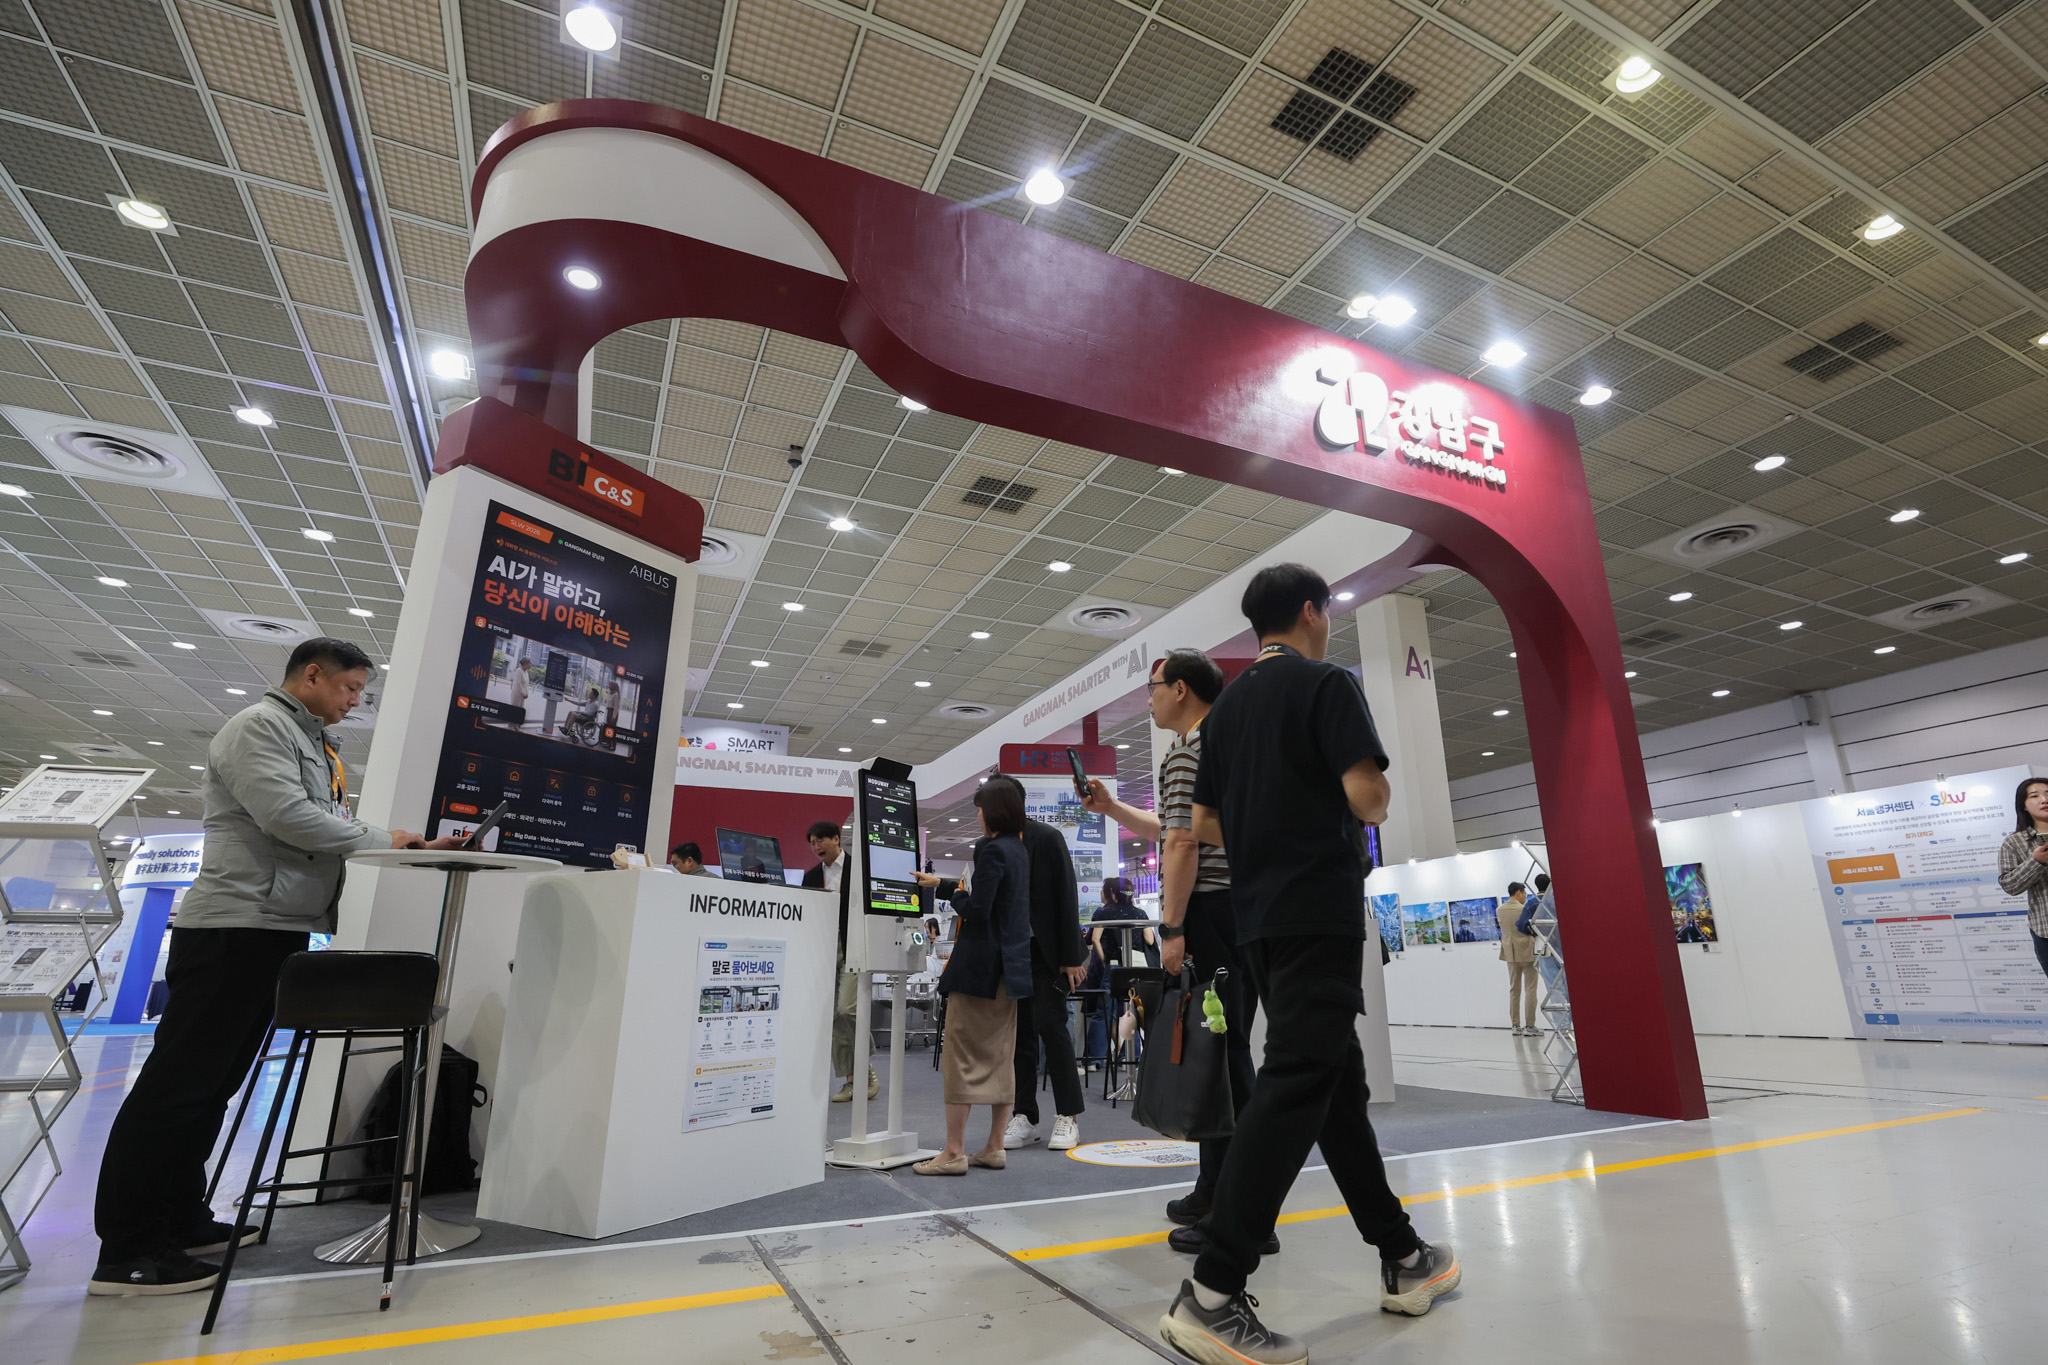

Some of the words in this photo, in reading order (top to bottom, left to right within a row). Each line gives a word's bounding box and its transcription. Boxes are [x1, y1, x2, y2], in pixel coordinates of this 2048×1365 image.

[1389, 389, 1505, 461] 강남구
[594, 477, 634, 507] C&S
[510, 519, 525, 530] SLW
[525, 525, 541, 536] 2026
[564, 541, 592, 557] GANGNAM
[629, 564, 670, 589] AIBUS
[487, 555, 538, 589] AI가
[543, 571, 606, 616] 말하고,
[483, 578, 548, 621] 당신이
[554, 604, 630, 648] 이해하는
[1257, 645, 1282, 657] NY
[1023, 694, 1067, 728] GANGNAM,
[1068, 666, 1111, 702] SMARTER
[1111, 654, 1128, 671] WITH
[1126, 642, 1148, 679] AI
[727, 737, 775, 751] SMART
[676, 756, 742, 774] NGNAM,
[745, 762, 814, 778] SMARTER
[816, 768, 838, 776] WITH
[1020, 750, 1049, 768] HR
[1039, 804, 1061, 813] 선택한
[1856, 800, 1915, 817] 서울앵커센터
[514, 832, 523, 840] Big
[524, 833, 536, 841] Data
[540, 835, 554, 843] Voice
[555, 837, 584, 848] Recognition
[158, 847, 200, 859] solutions
[689, 893, 803, 922] INFORMATION
[712, 960, 730, 975] 말로
[732, 960, 775, 975] 물어보세요
